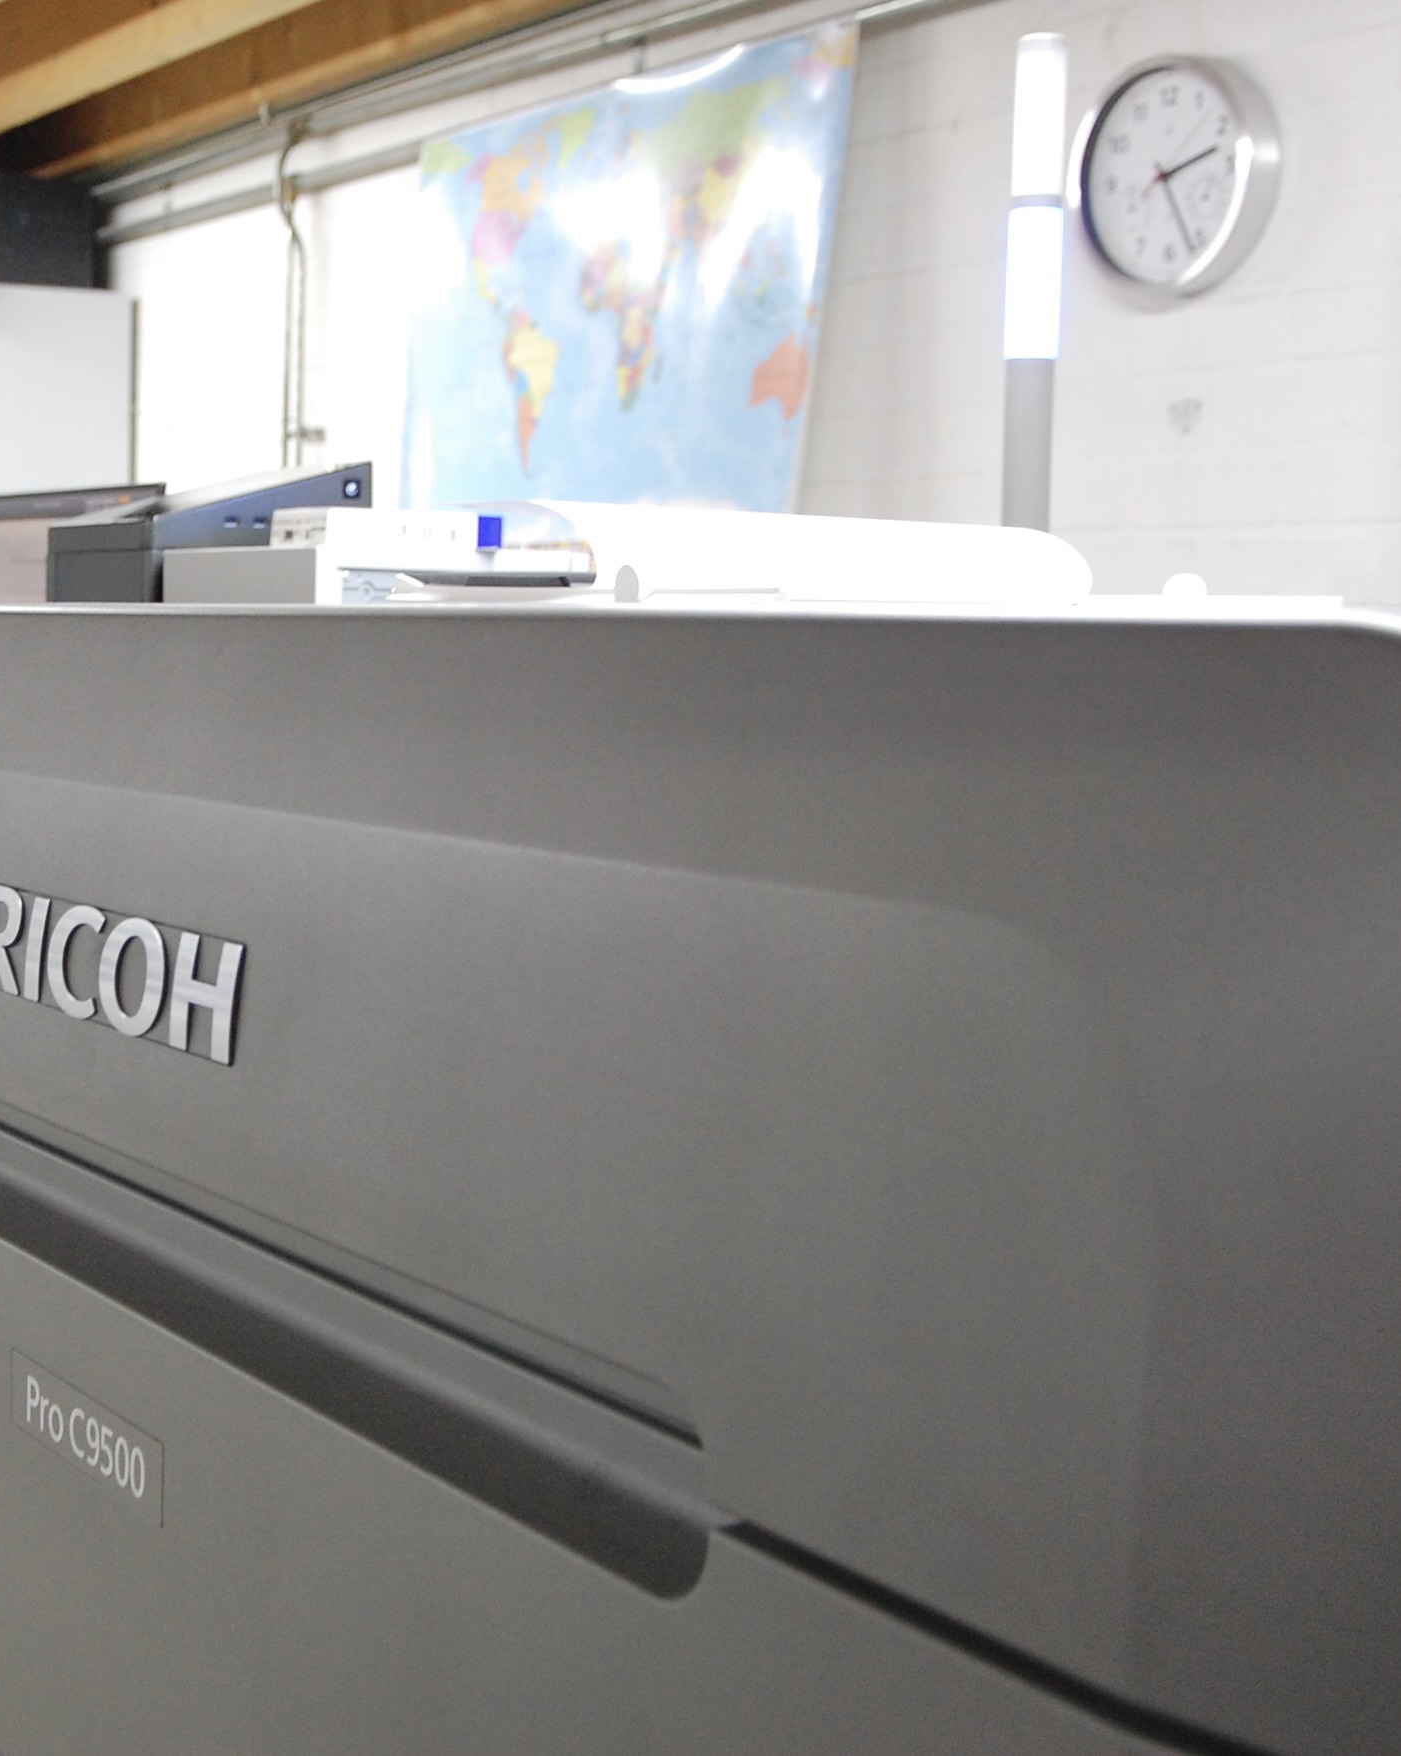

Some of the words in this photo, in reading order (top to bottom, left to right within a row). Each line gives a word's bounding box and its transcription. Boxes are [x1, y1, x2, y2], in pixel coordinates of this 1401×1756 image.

[1160, 85, 1180, 107] 12
[1216, 113, 1231, 137] 2
[1109, 133, 1131, 155] 10
[1105, 173, 1119, 196] 9
[1135, 235, 1148, 259] 7
[1161, 241, 1177, 265] 6
[26, 1374, 64, 1443] Pro
[69, 1407, 146, 1499] C9500
